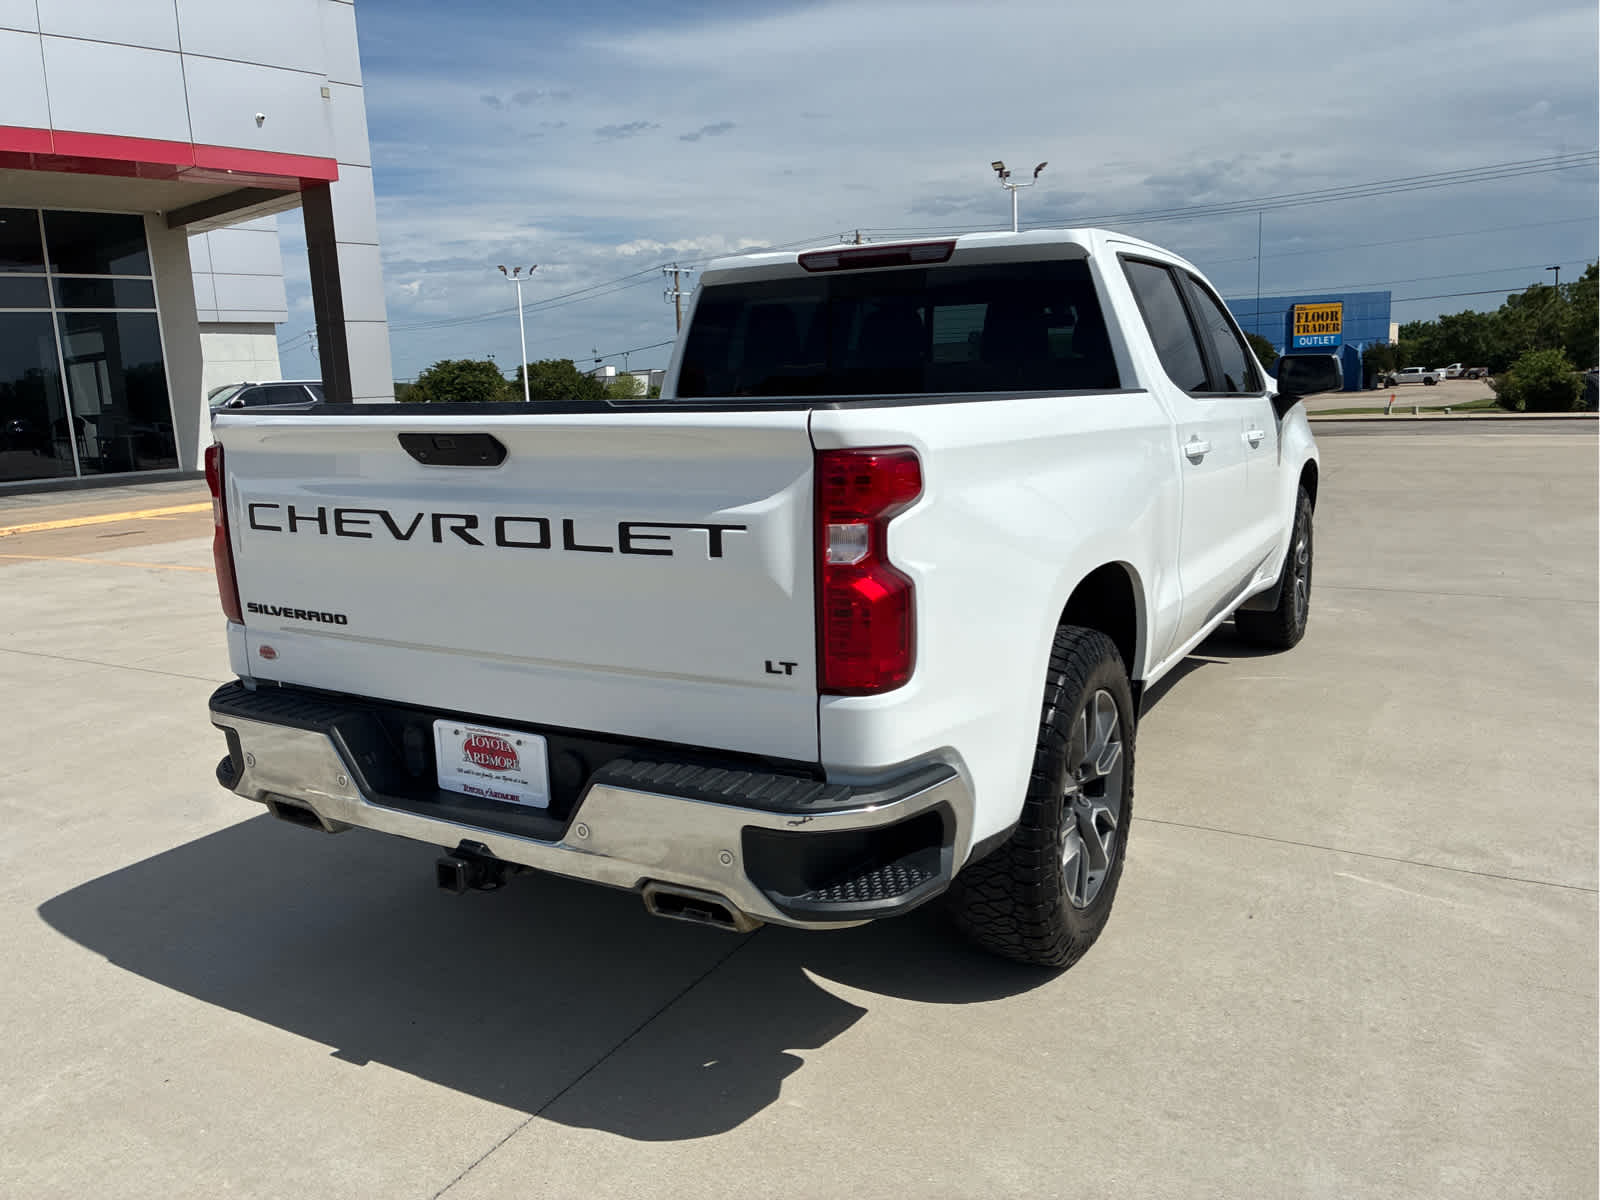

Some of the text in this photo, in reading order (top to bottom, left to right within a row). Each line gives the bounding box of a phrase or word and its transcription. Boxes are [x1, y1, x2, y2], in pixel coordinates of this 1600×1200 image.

[1296, 311, 1338, 323] FLOOR
[1295, 323, 1340, 333] TRADER
[1299, 336, 1336, 345] OUTLET
[248, 503, 747, 558] CHEVROLET
[247, 602, 348, 625] SILVERADO
[765, 660, 798, 675] LT
[468, 733, 513, 753] TOYOTA
[463, 749, 521, 771] ARDMORE
